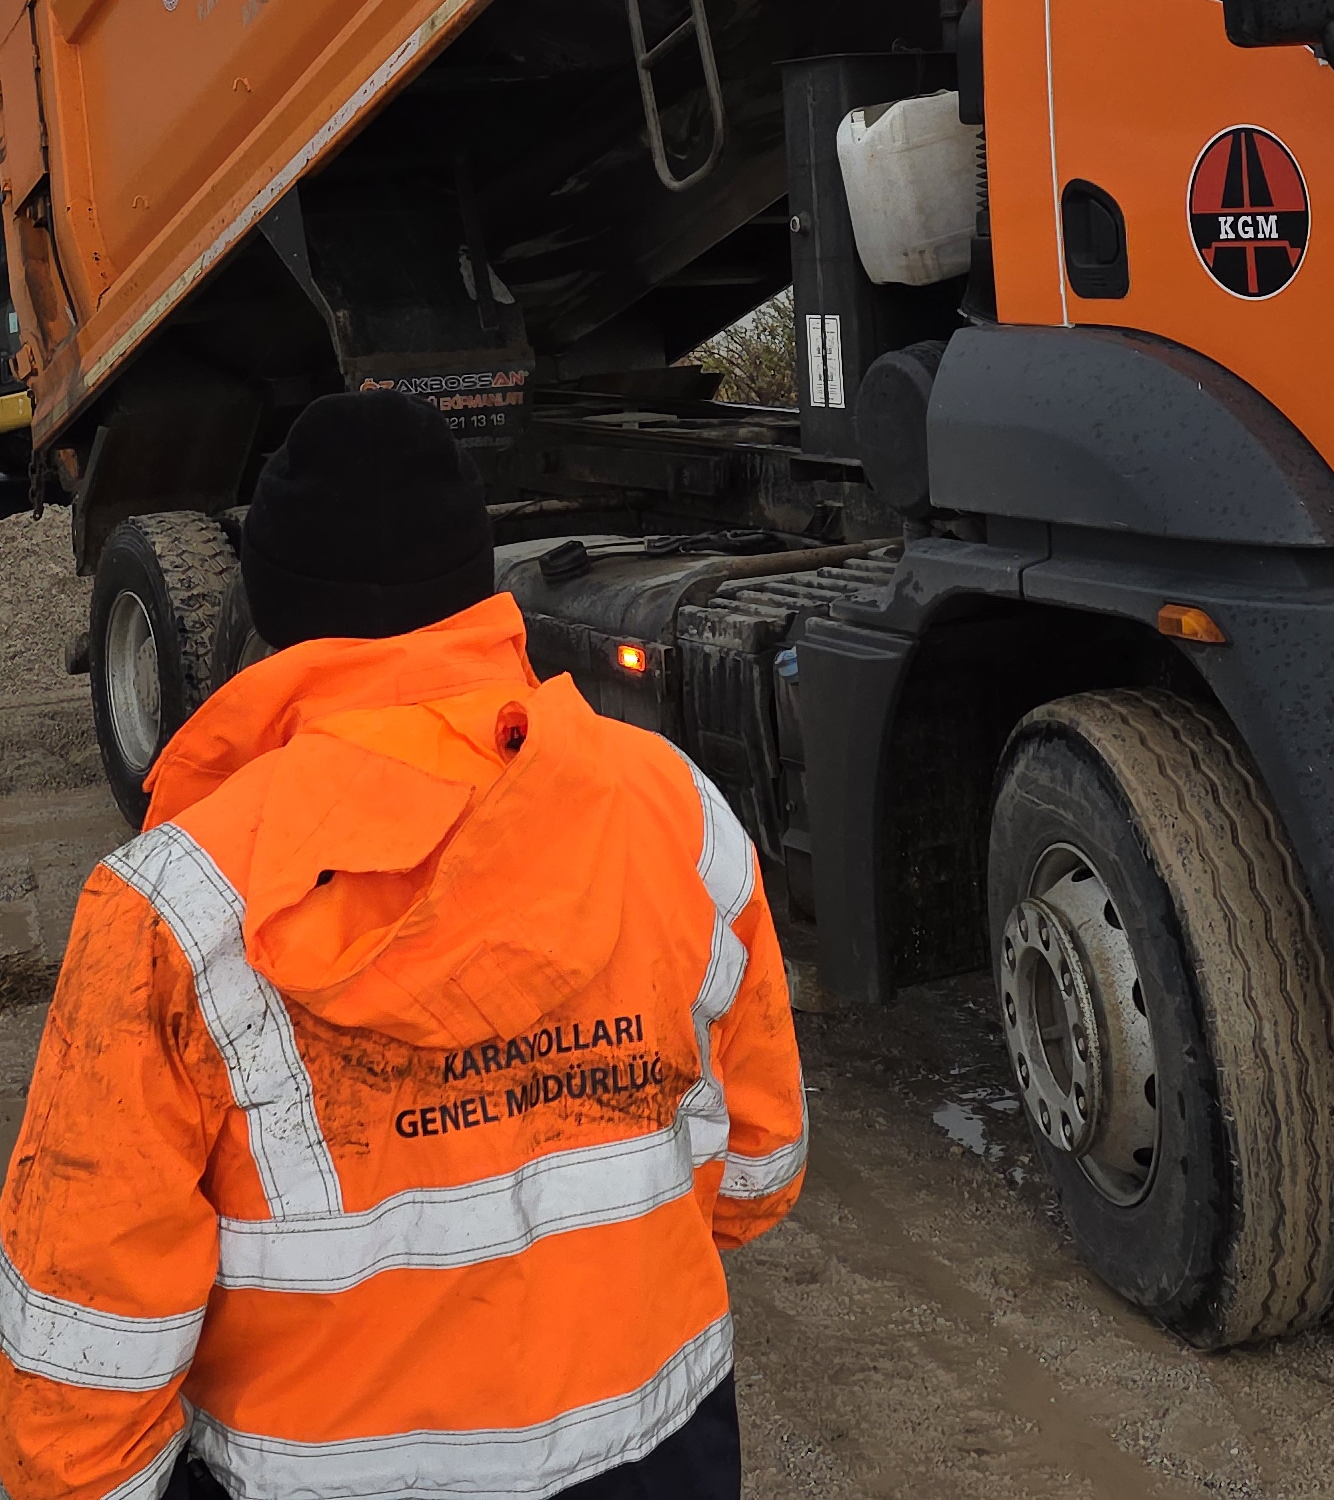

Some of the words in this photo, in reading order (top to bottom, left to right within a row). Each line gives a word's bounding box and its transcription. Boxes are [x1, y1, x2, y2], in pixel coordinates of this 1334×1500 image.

[1218, 215, 1279, 240] KGM
[471, 414, 487, 427] 13
[490, 412, 506, 427] 19
[444, 1014, 643, 1083] KARAYOLLARI
[395, 1094, 499, 1138] GENEL
